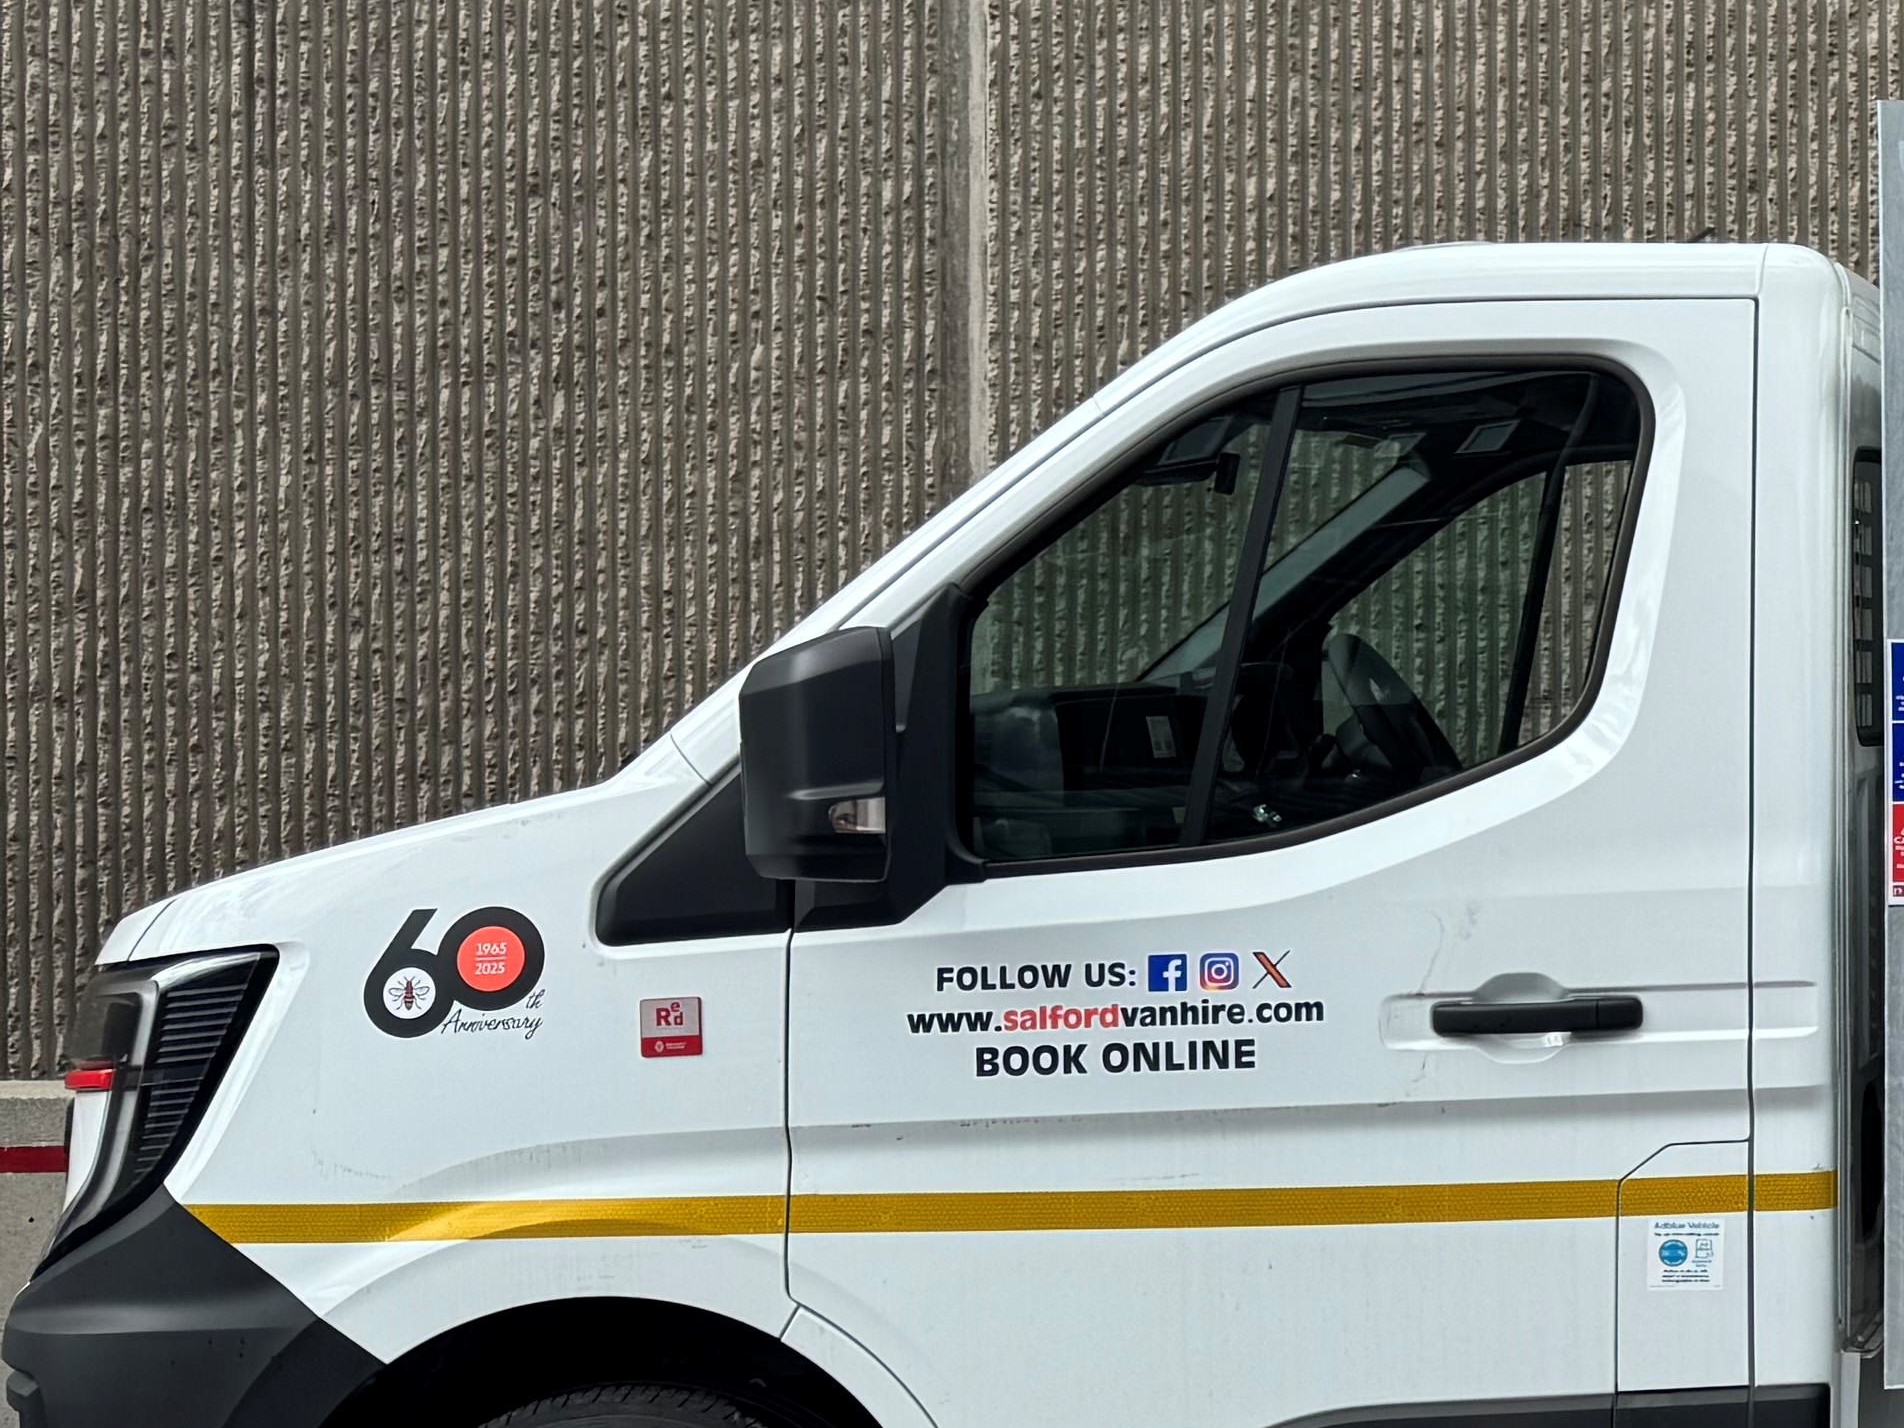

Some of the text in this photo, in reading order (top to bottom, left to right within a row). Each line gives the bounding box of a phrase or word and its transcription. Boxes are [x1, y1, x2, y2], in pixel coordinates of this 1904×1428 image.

[476, 942, 507, 956] 1965
[475, 962, 506, 975] 2025
[936, 962, 1136, 992] FOLLOW US:
[440, 1008, 544, 1040] Anniversary
[907, 998, 1324, 1034] www.salfordvanhire.com
[976, 1038, 1256, 1077] BOOK ONLINE
